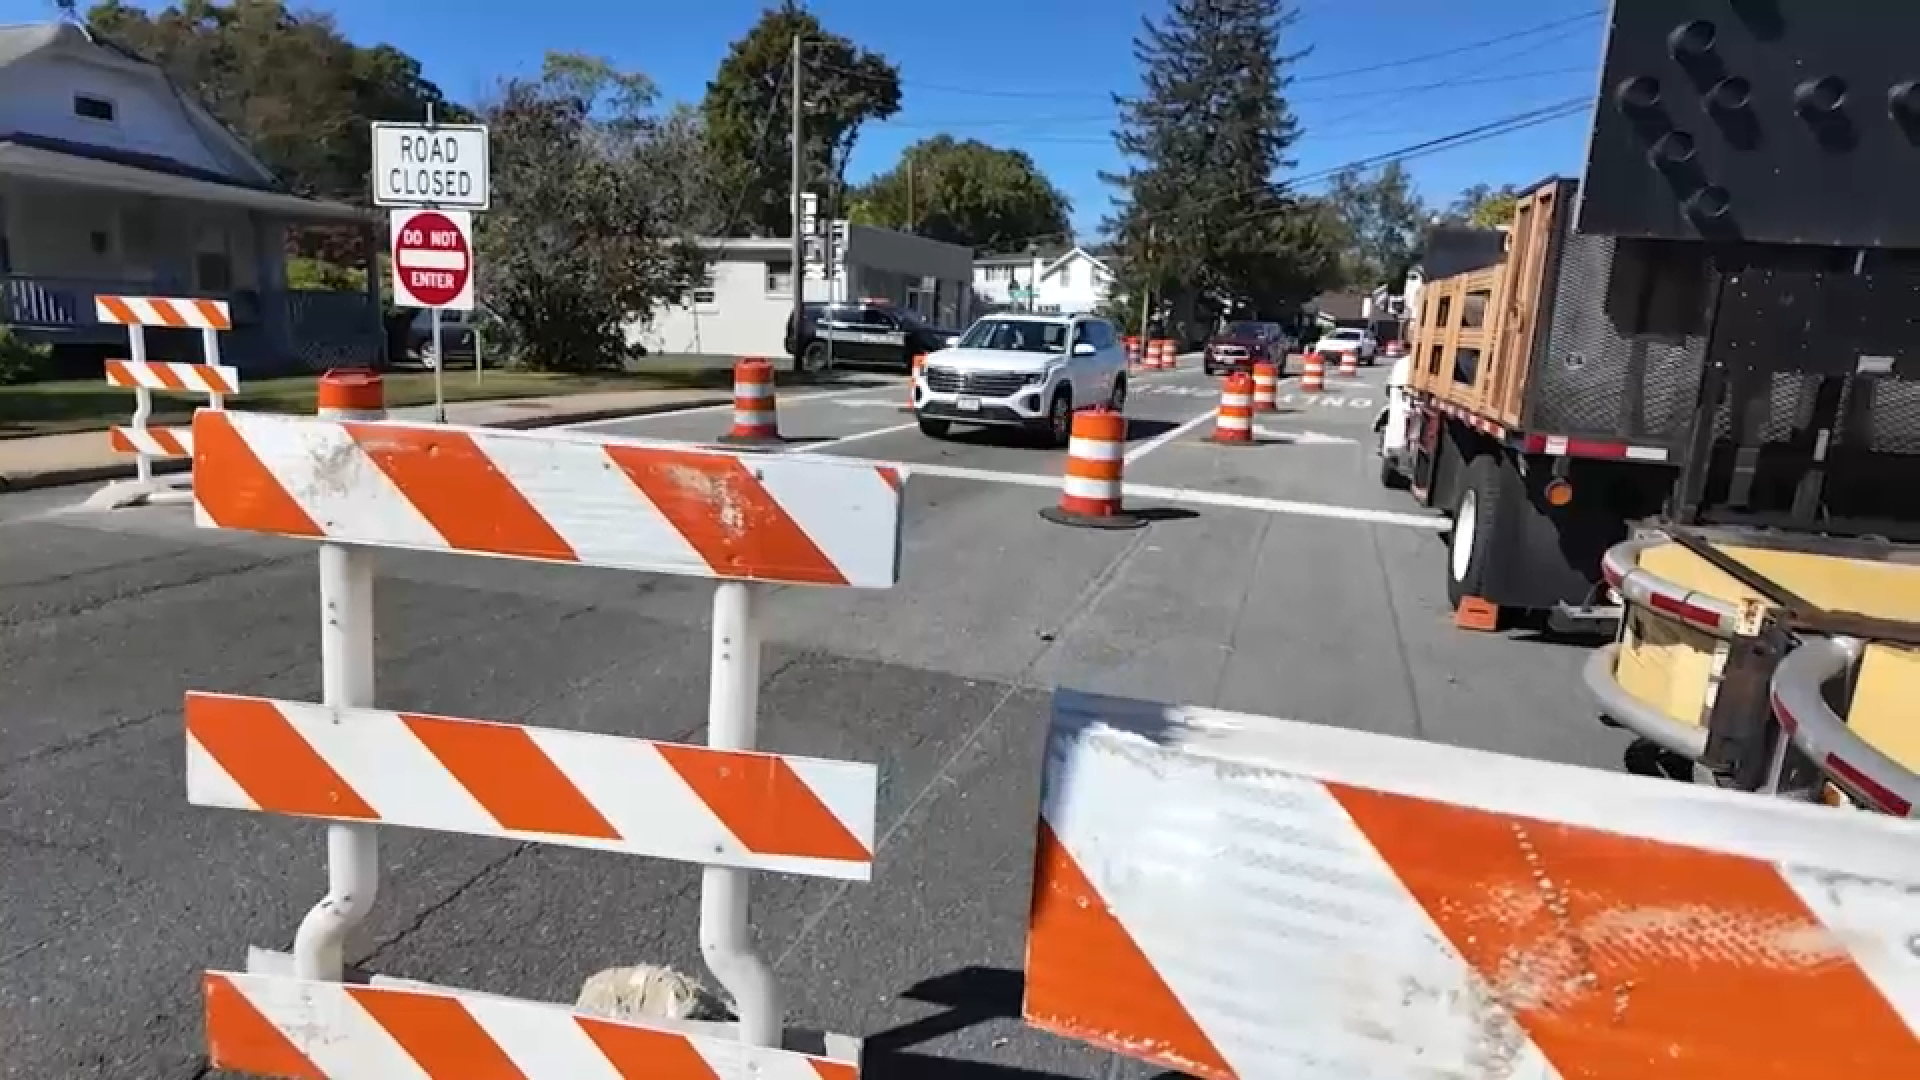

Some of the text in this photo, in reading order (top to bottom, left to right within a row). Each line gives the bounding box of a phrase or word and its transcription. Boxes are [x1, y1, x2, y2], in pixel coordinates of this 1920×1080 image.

[400, 135, 459, 163] ROAD
[390, 168, 471, 197] CLOSED
[403, 229, 457, 248] DO NOT
[411, 271, 455, 289] ENTER
